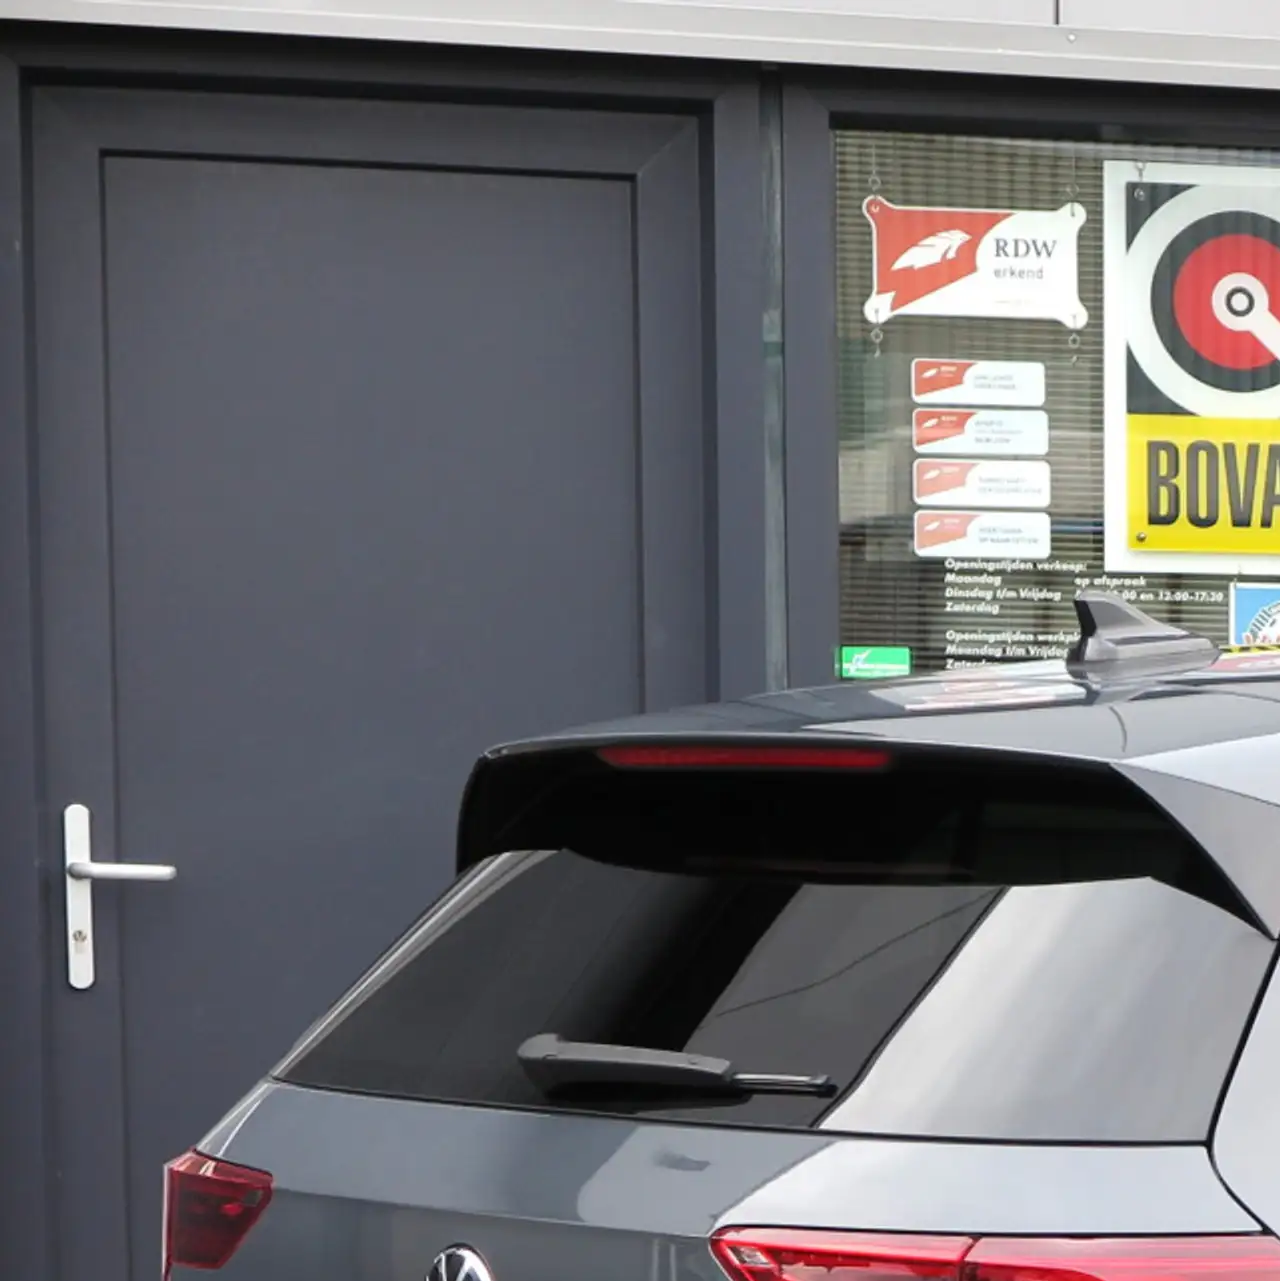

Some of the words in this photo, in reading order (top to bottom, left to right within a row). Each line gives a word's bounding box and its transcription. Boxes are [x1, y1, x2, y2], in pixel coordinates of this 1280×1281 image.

[994, 238, 1057, 258] RDW
[994, 265, 1043, 279] erkend
[945, 572, 1002, 587] Maandag
[1074, 578, 1090, 588] op
[945, 587, 994, 601] Dinsdag
[1019, 588, 1062, 602] Vrijdag
[1139, 592, 1154, 600] en
[944, 601, 1000, 616] Zaterdag
[945, 644, 1003, 657] Maandag
